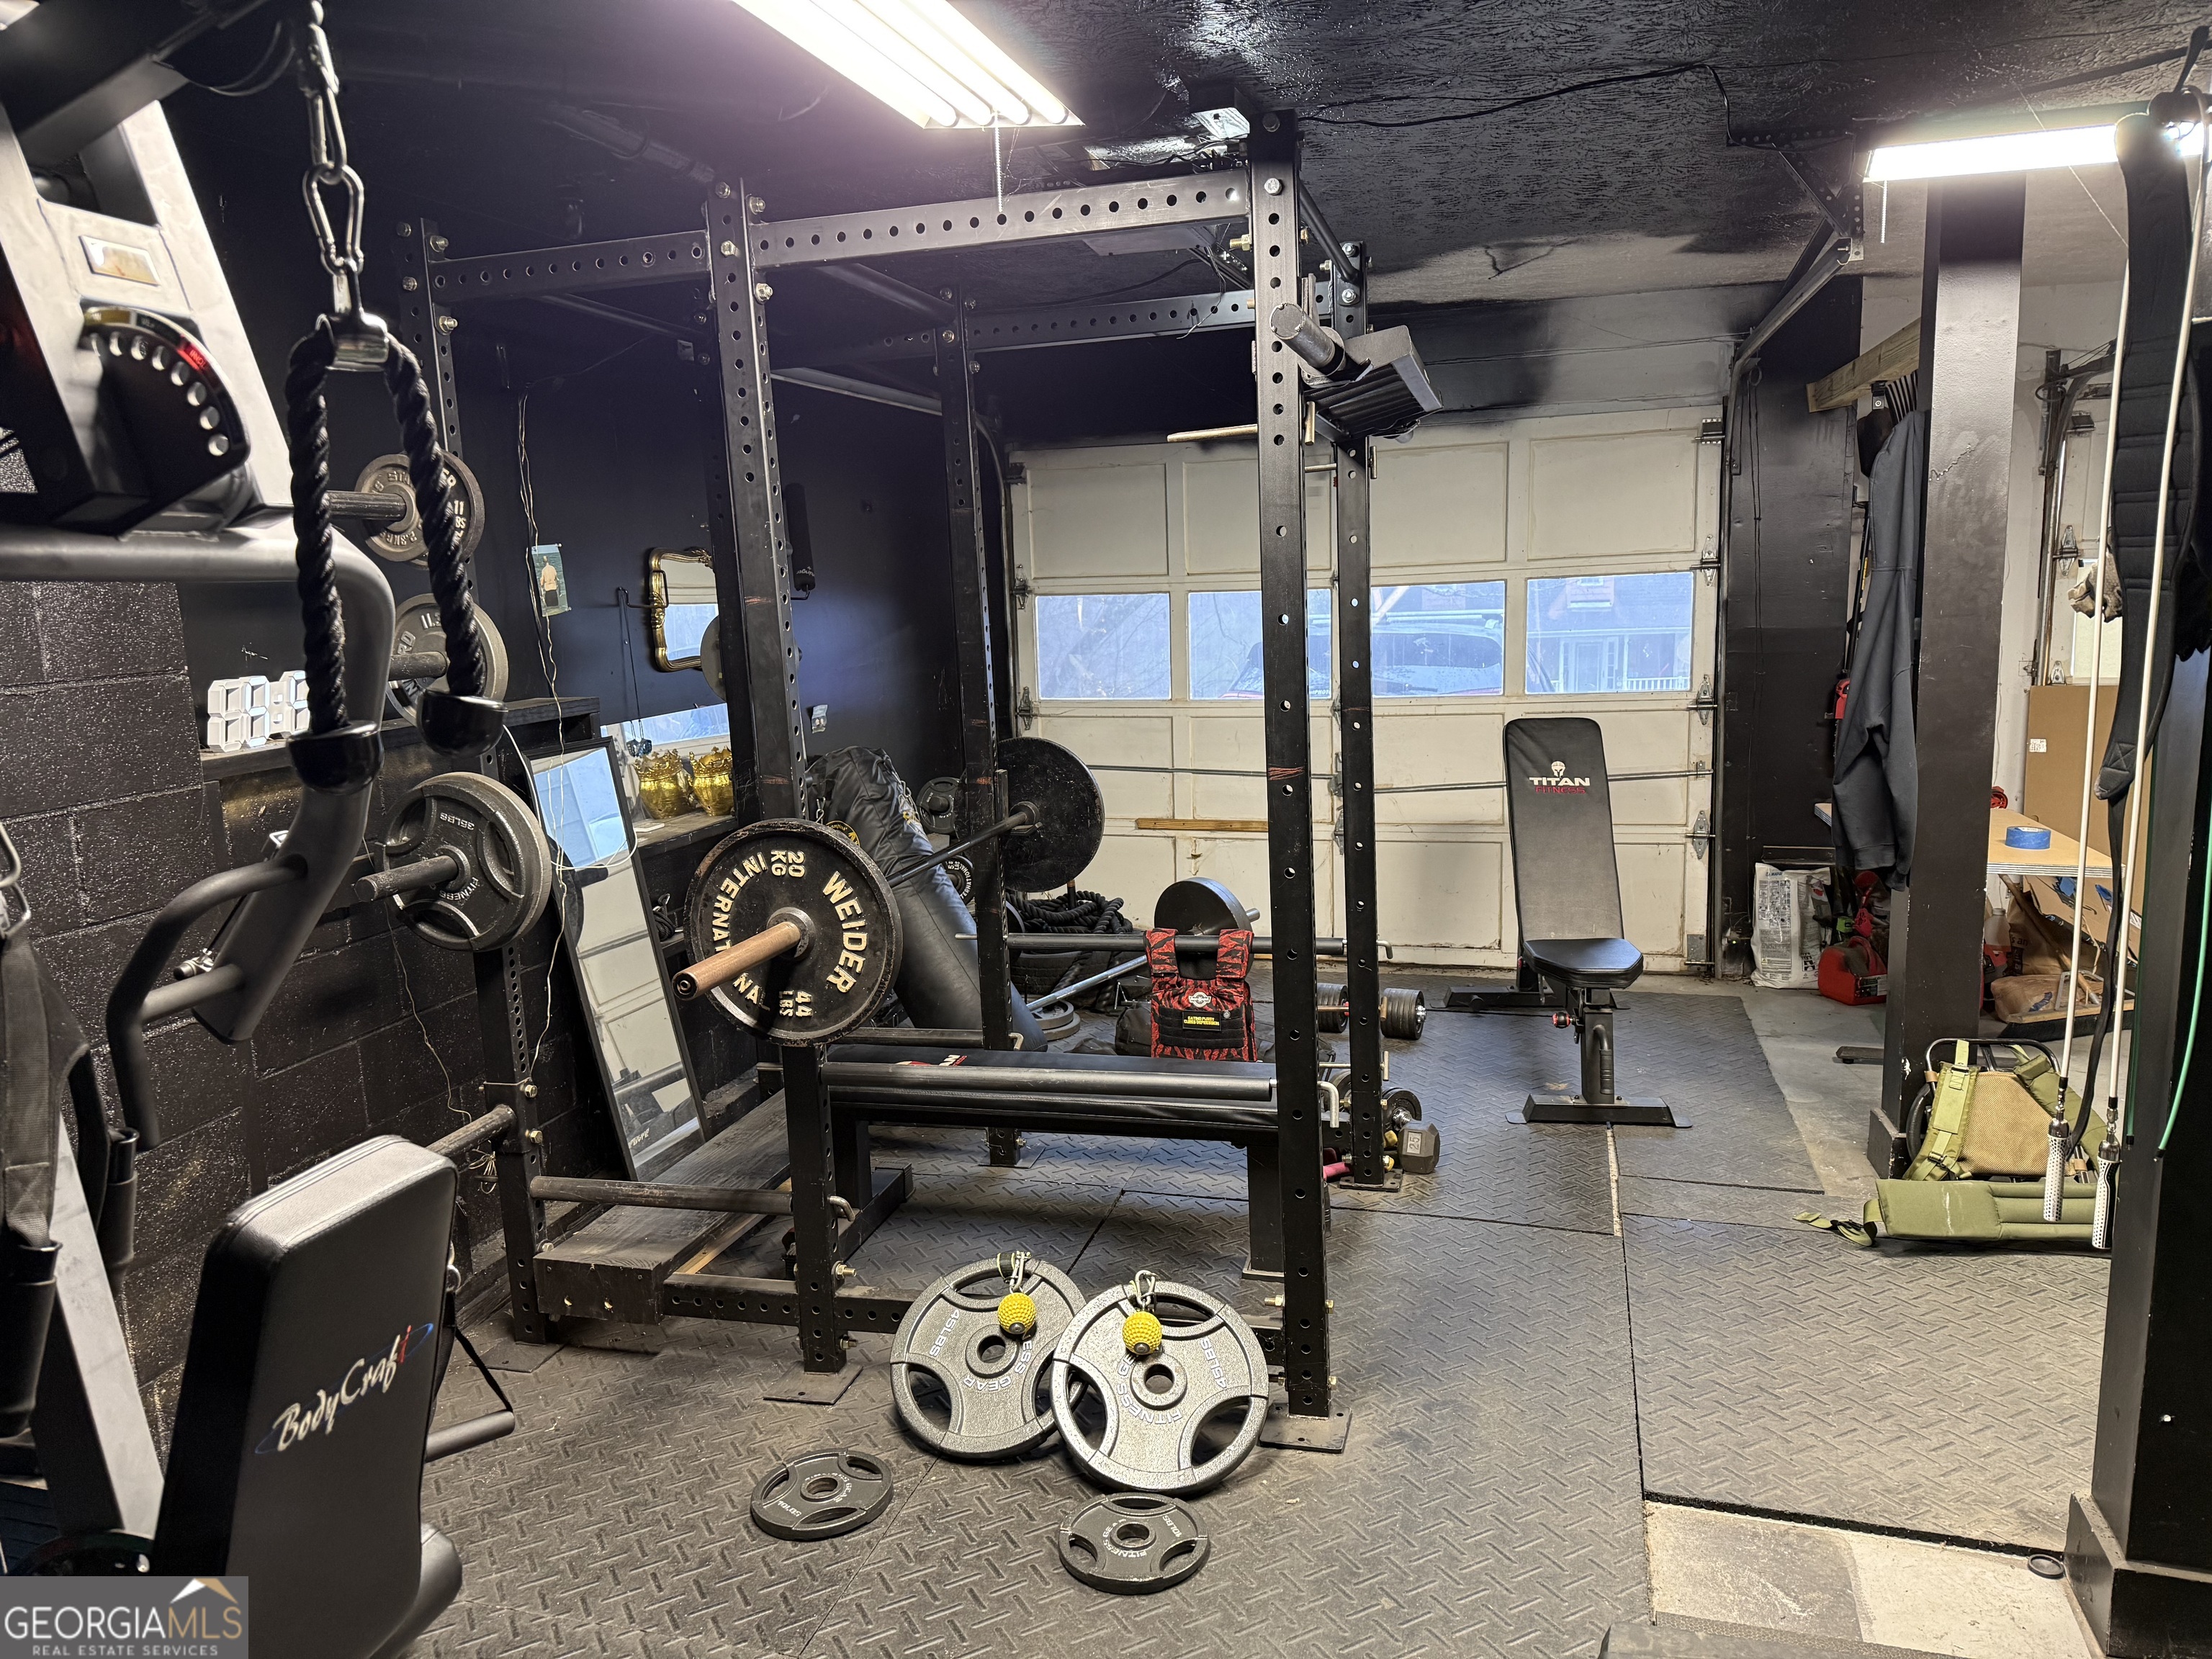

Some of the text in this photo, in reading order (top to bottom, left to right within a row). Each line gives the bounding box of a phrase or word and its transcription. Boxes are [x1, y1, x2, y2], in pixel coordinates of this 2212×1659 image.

[1529, 777, 1590, 786] TITAN
[770, 850, 786, 876] KG
[788, 850, 806, 878] 20
[960, 863, 972, 899] TERNATIONAL
[712, 852, 770, 1012] INTERNATNAL
[823, 871, 868, 993] WEIDER
[779, 989, 793, 1017] LBS
[795, 989, 814, 1017] 44
[1409, 1136, 1420, 1150] 25
[930, 1309, 960, 1357] 45LBS
[1200, 1338, 1227, 1389] 45LBS
[963, 1375, 1012, 1392] GEAR
[1117, 1353, 1183, 1424] FITNESS GE
[1162, 1515, 1182, 1538] 10LBS
[1102, 1539, 1148, 1558] FITNESS
